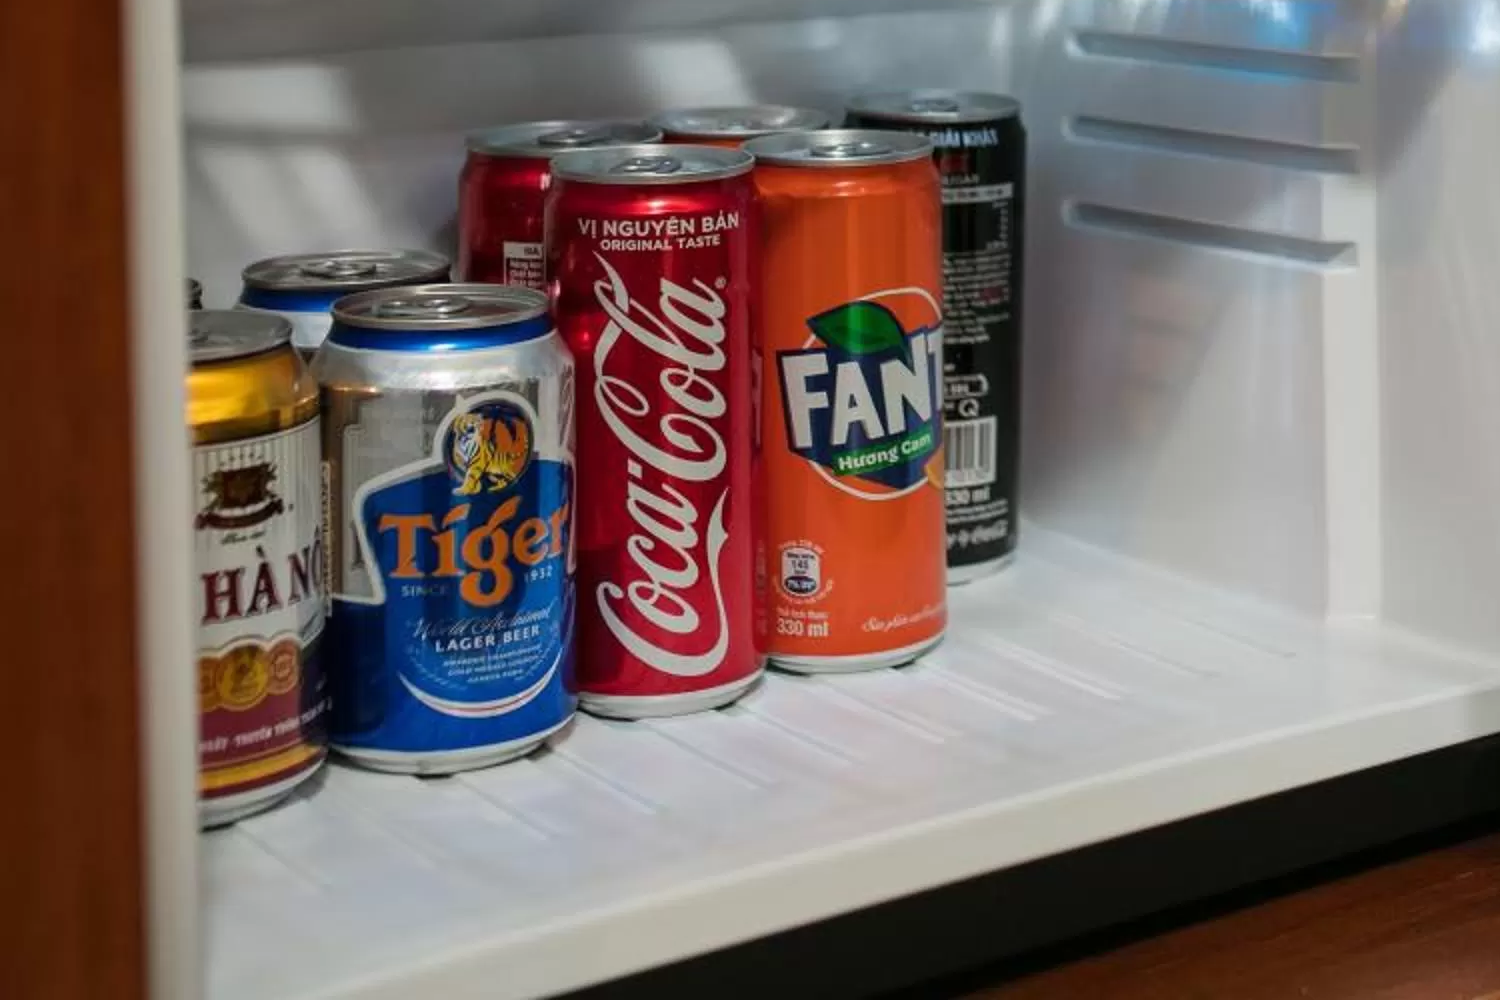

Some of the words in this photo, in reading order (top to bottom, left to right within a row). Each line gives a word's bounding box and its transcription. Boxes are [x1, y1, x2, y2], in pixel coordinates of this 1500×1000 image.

[602, 215, 696, 238] NGUYÊN
[599, 238, 672, 251] ORIGINAL
[676, 233, 721, 249] TASTE
[781, 325, 945, 449] FANT
[900, 432, 932, 455] Cam
[377, 496, 570, 608] Tiger
[434, 633, 496, 653] LAGER
[503, 624, 540, 645] BEER
